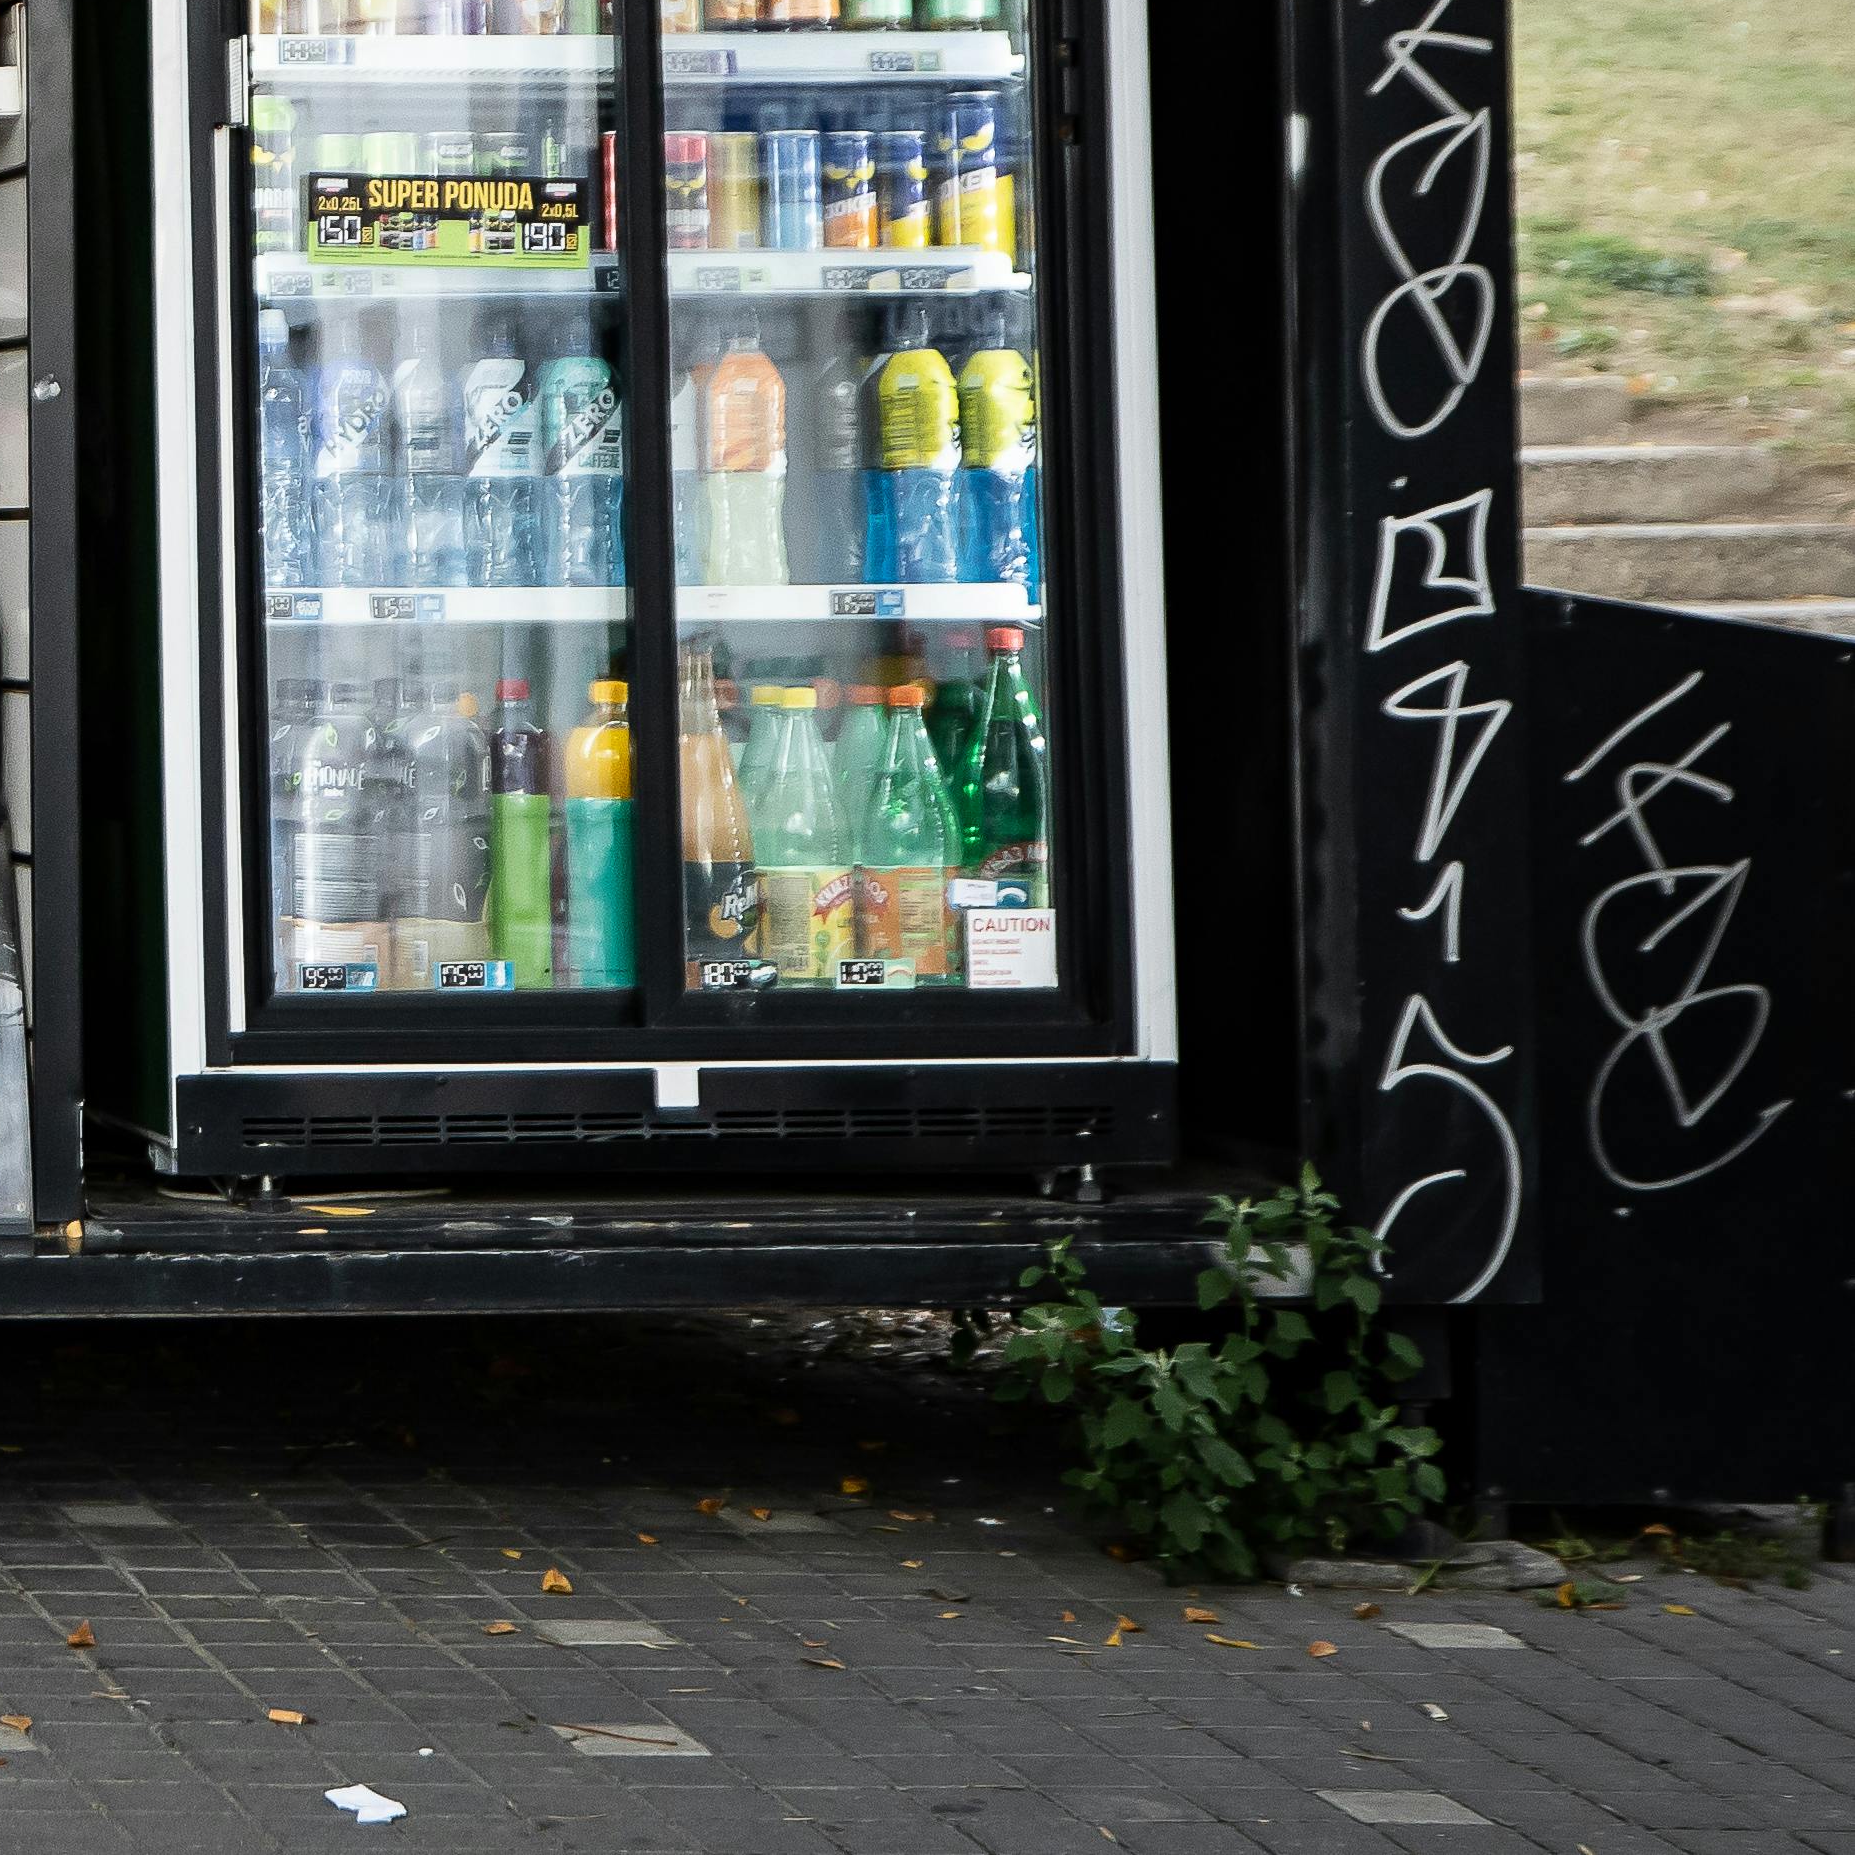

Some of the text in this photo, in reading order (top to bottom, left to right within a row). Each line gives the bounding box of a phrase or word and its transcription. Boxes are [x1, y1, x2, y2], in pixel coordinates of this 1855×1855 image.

[367, 178, 534, 210] SUPER PONUDA
[319, 215, 361, 244] 150
[523, 222, 566, 251] 190
[475, 389, 524, 446] ZERO
[564, 391, 615, 448] ZERO
[973, 917, 1051, 933] CAUTION
